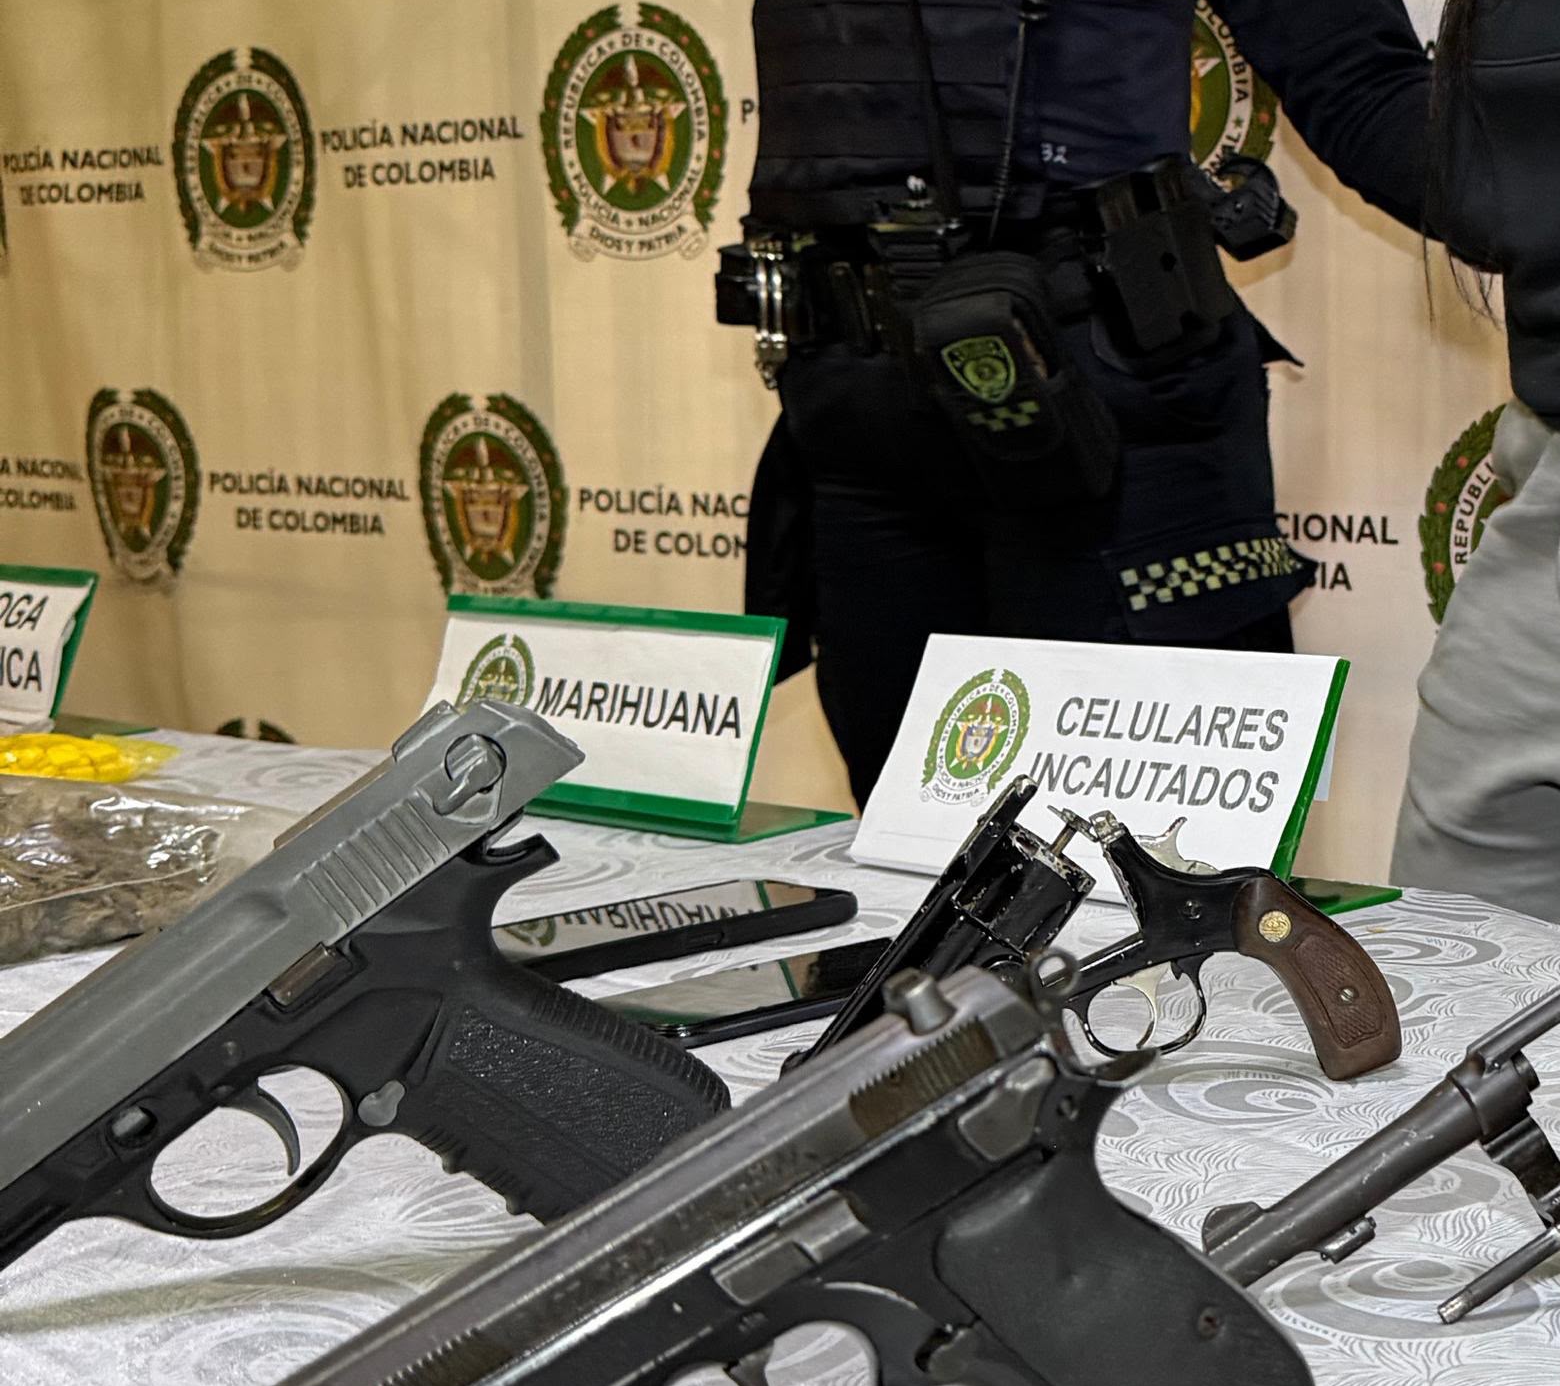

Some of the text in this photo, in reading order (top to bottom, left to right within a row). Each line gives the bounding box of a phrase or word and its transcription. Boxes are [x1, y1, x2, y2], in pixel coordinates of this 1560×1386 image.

[400, 115, 524, 147] NACIONAL
[344, 157, 496, 188] DE COLOMBIA
[297, 475, 410, 501] NACIONAL
[578, 485, 683, 515] POLICÍA
[236, 506, 386, 534] DE COLOMBIA
[614, 529, 646, 553] DE
[539, 676, 742, 739] MARIHUANA
[1056, 696, 1289, 752] CELULARES
